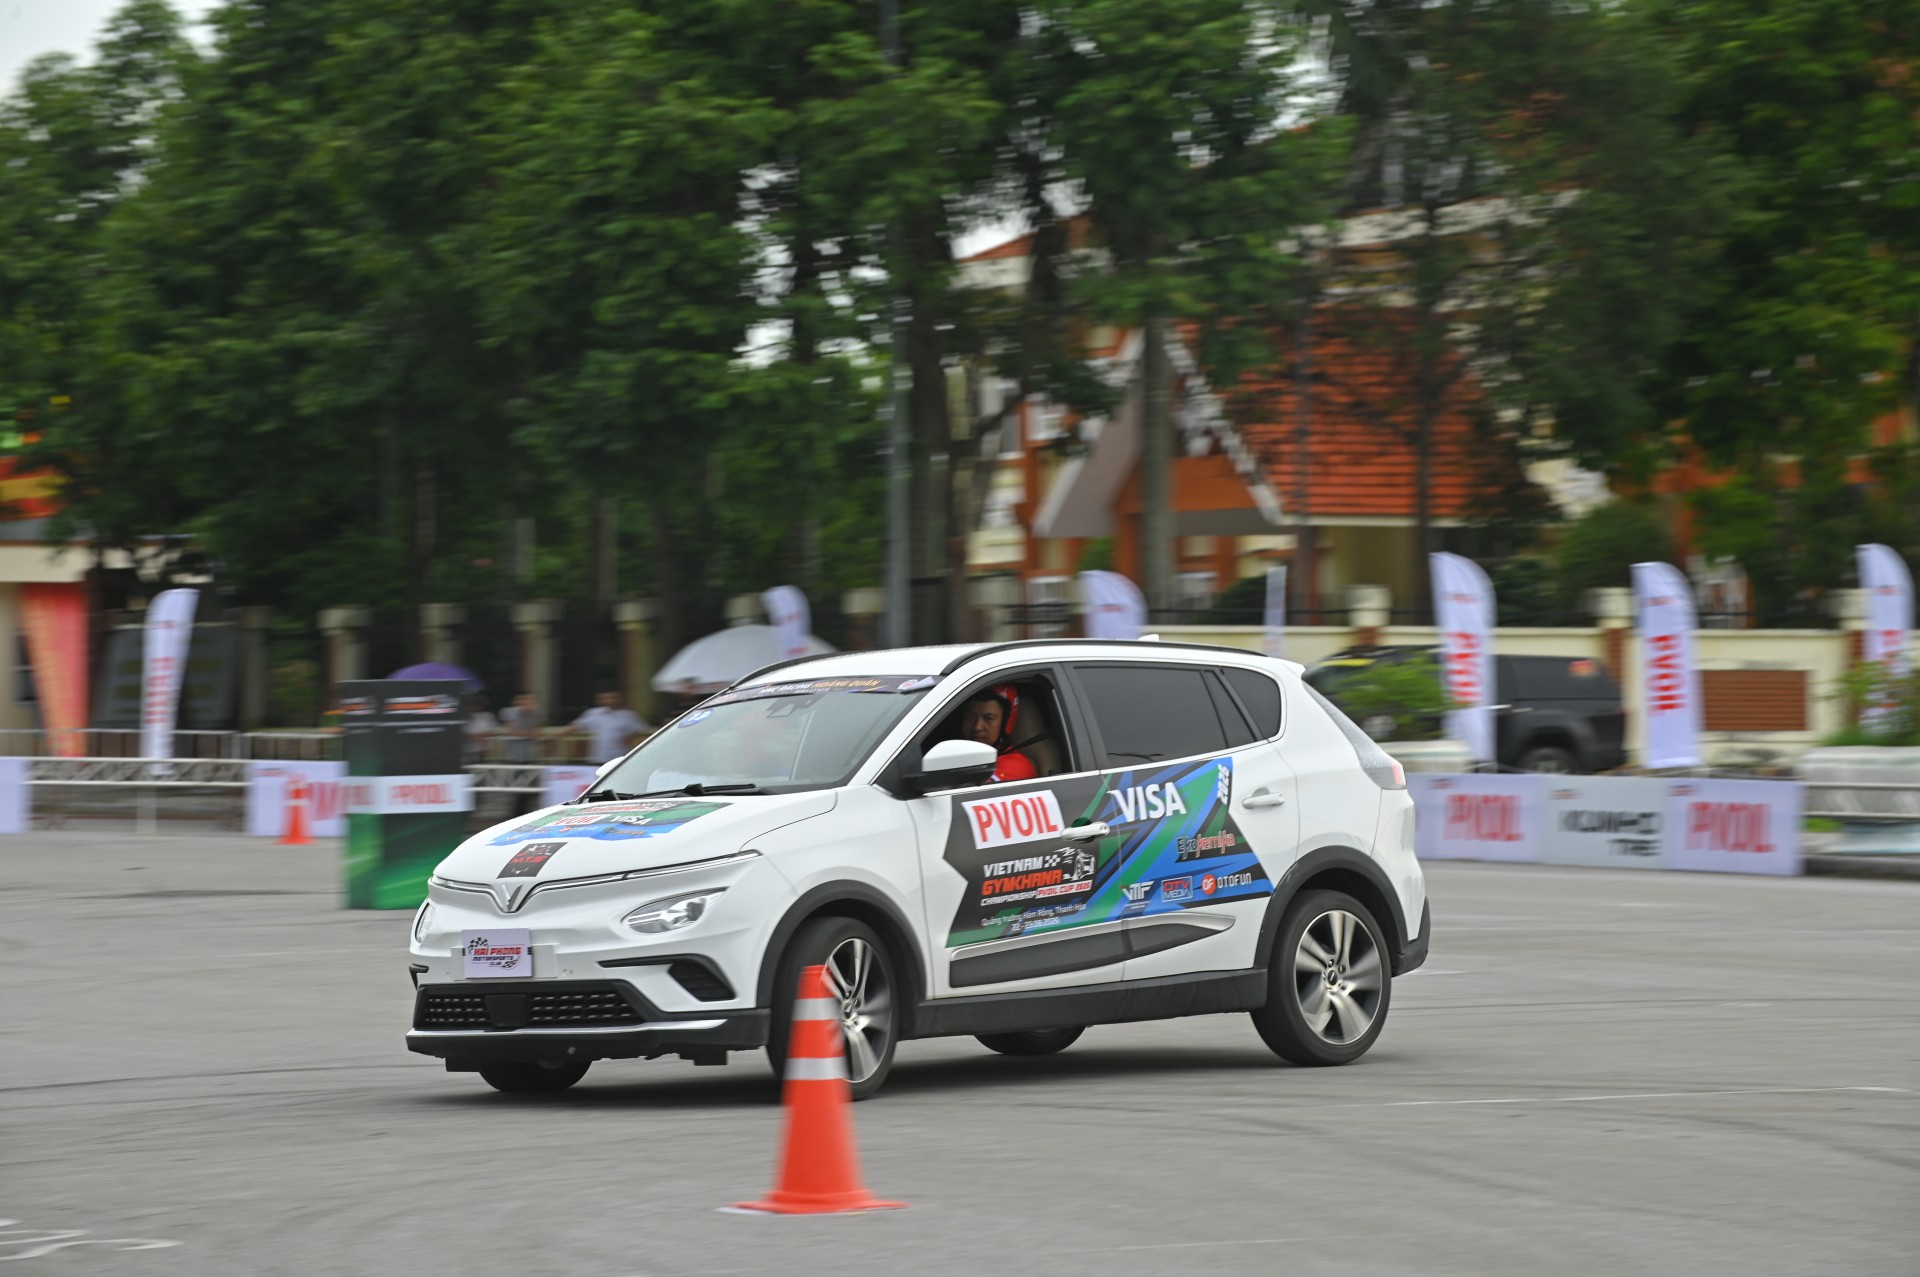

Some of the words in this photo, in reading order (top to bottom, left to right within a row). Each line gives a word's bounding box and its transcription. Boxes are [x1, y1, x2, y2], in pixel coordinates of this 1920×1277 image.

[1106, 782, 1187, 822] VISA
[972, 795, 1059, 842] PVOIL
[983, 856, 1043, 878] VIETNAM
[981, 869, 1063, 896] GYMKHANA
[1217, 872, 1252, 889] OTOFUN
[473, 947, 490, 956] HAI
